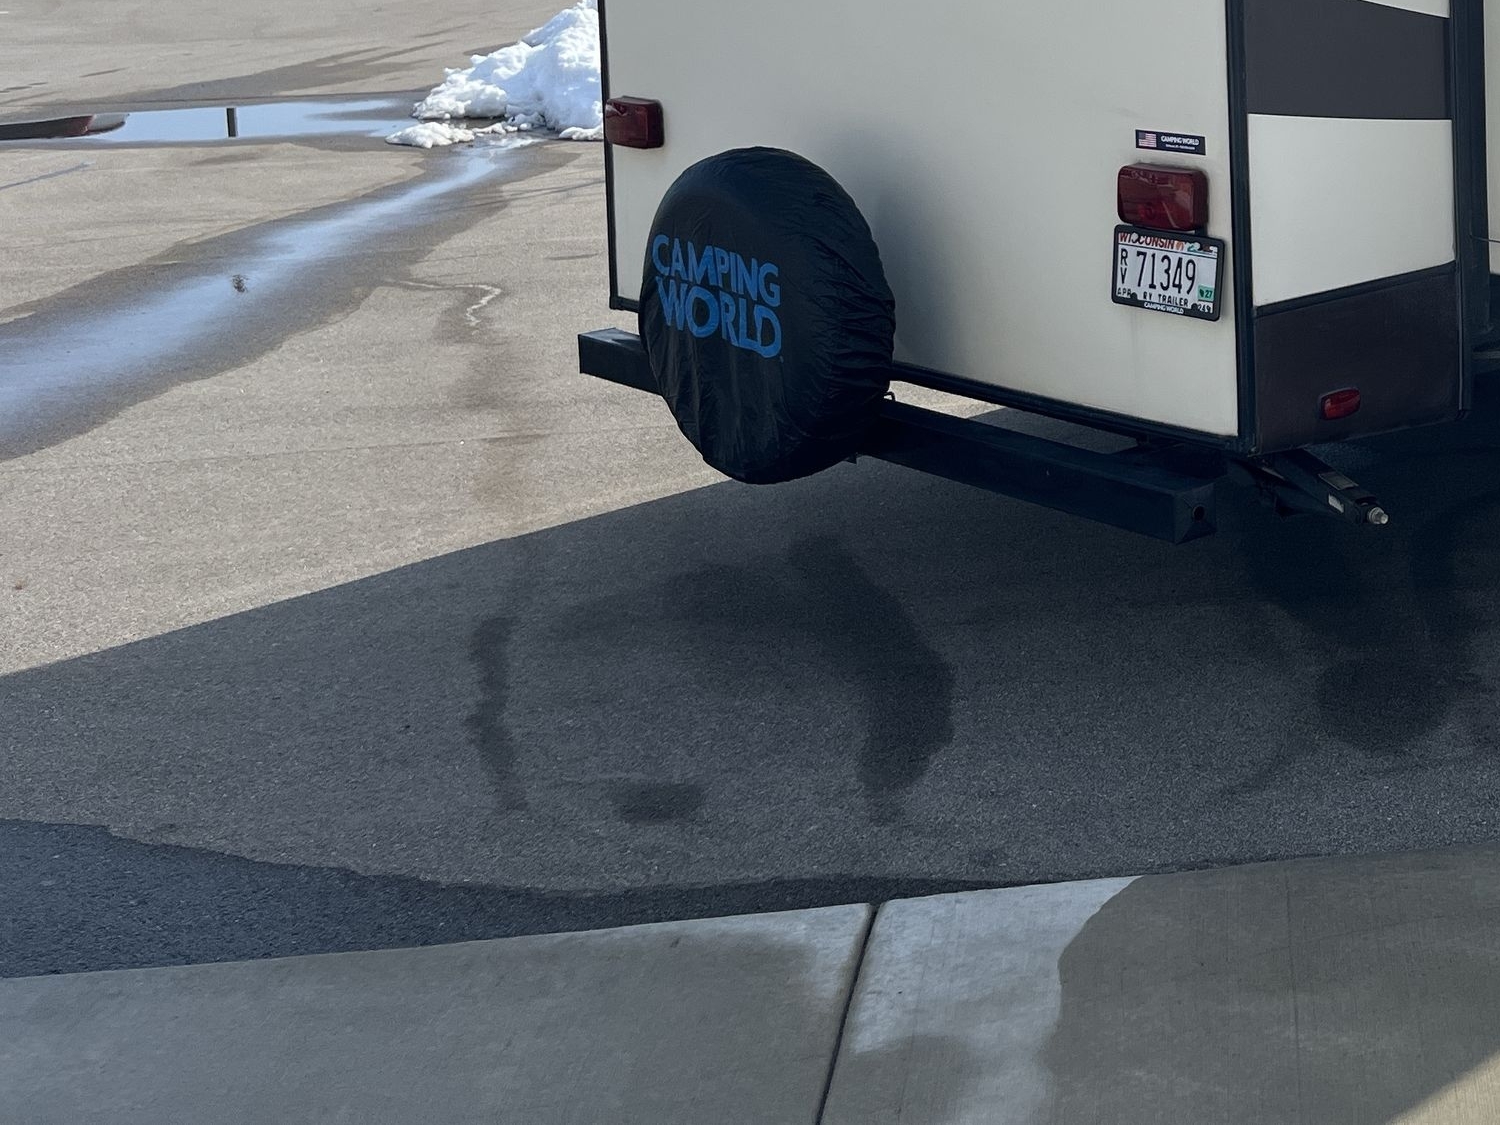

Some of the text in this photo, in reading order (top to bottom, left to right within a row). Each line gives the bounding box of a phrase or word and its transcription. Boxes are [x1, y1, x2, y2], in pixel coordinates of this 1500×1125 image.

[1160, 135, 1200, 146] CAMPING WORLD
[652, 234, 781, 307] CAMPING
[1136, 251, 1196, 295] 71349
[1158, 293, 1189, 308] TRAILER
[1205, 290, 1213, 298] 27
[655, 276, 782, 358] WORLD
